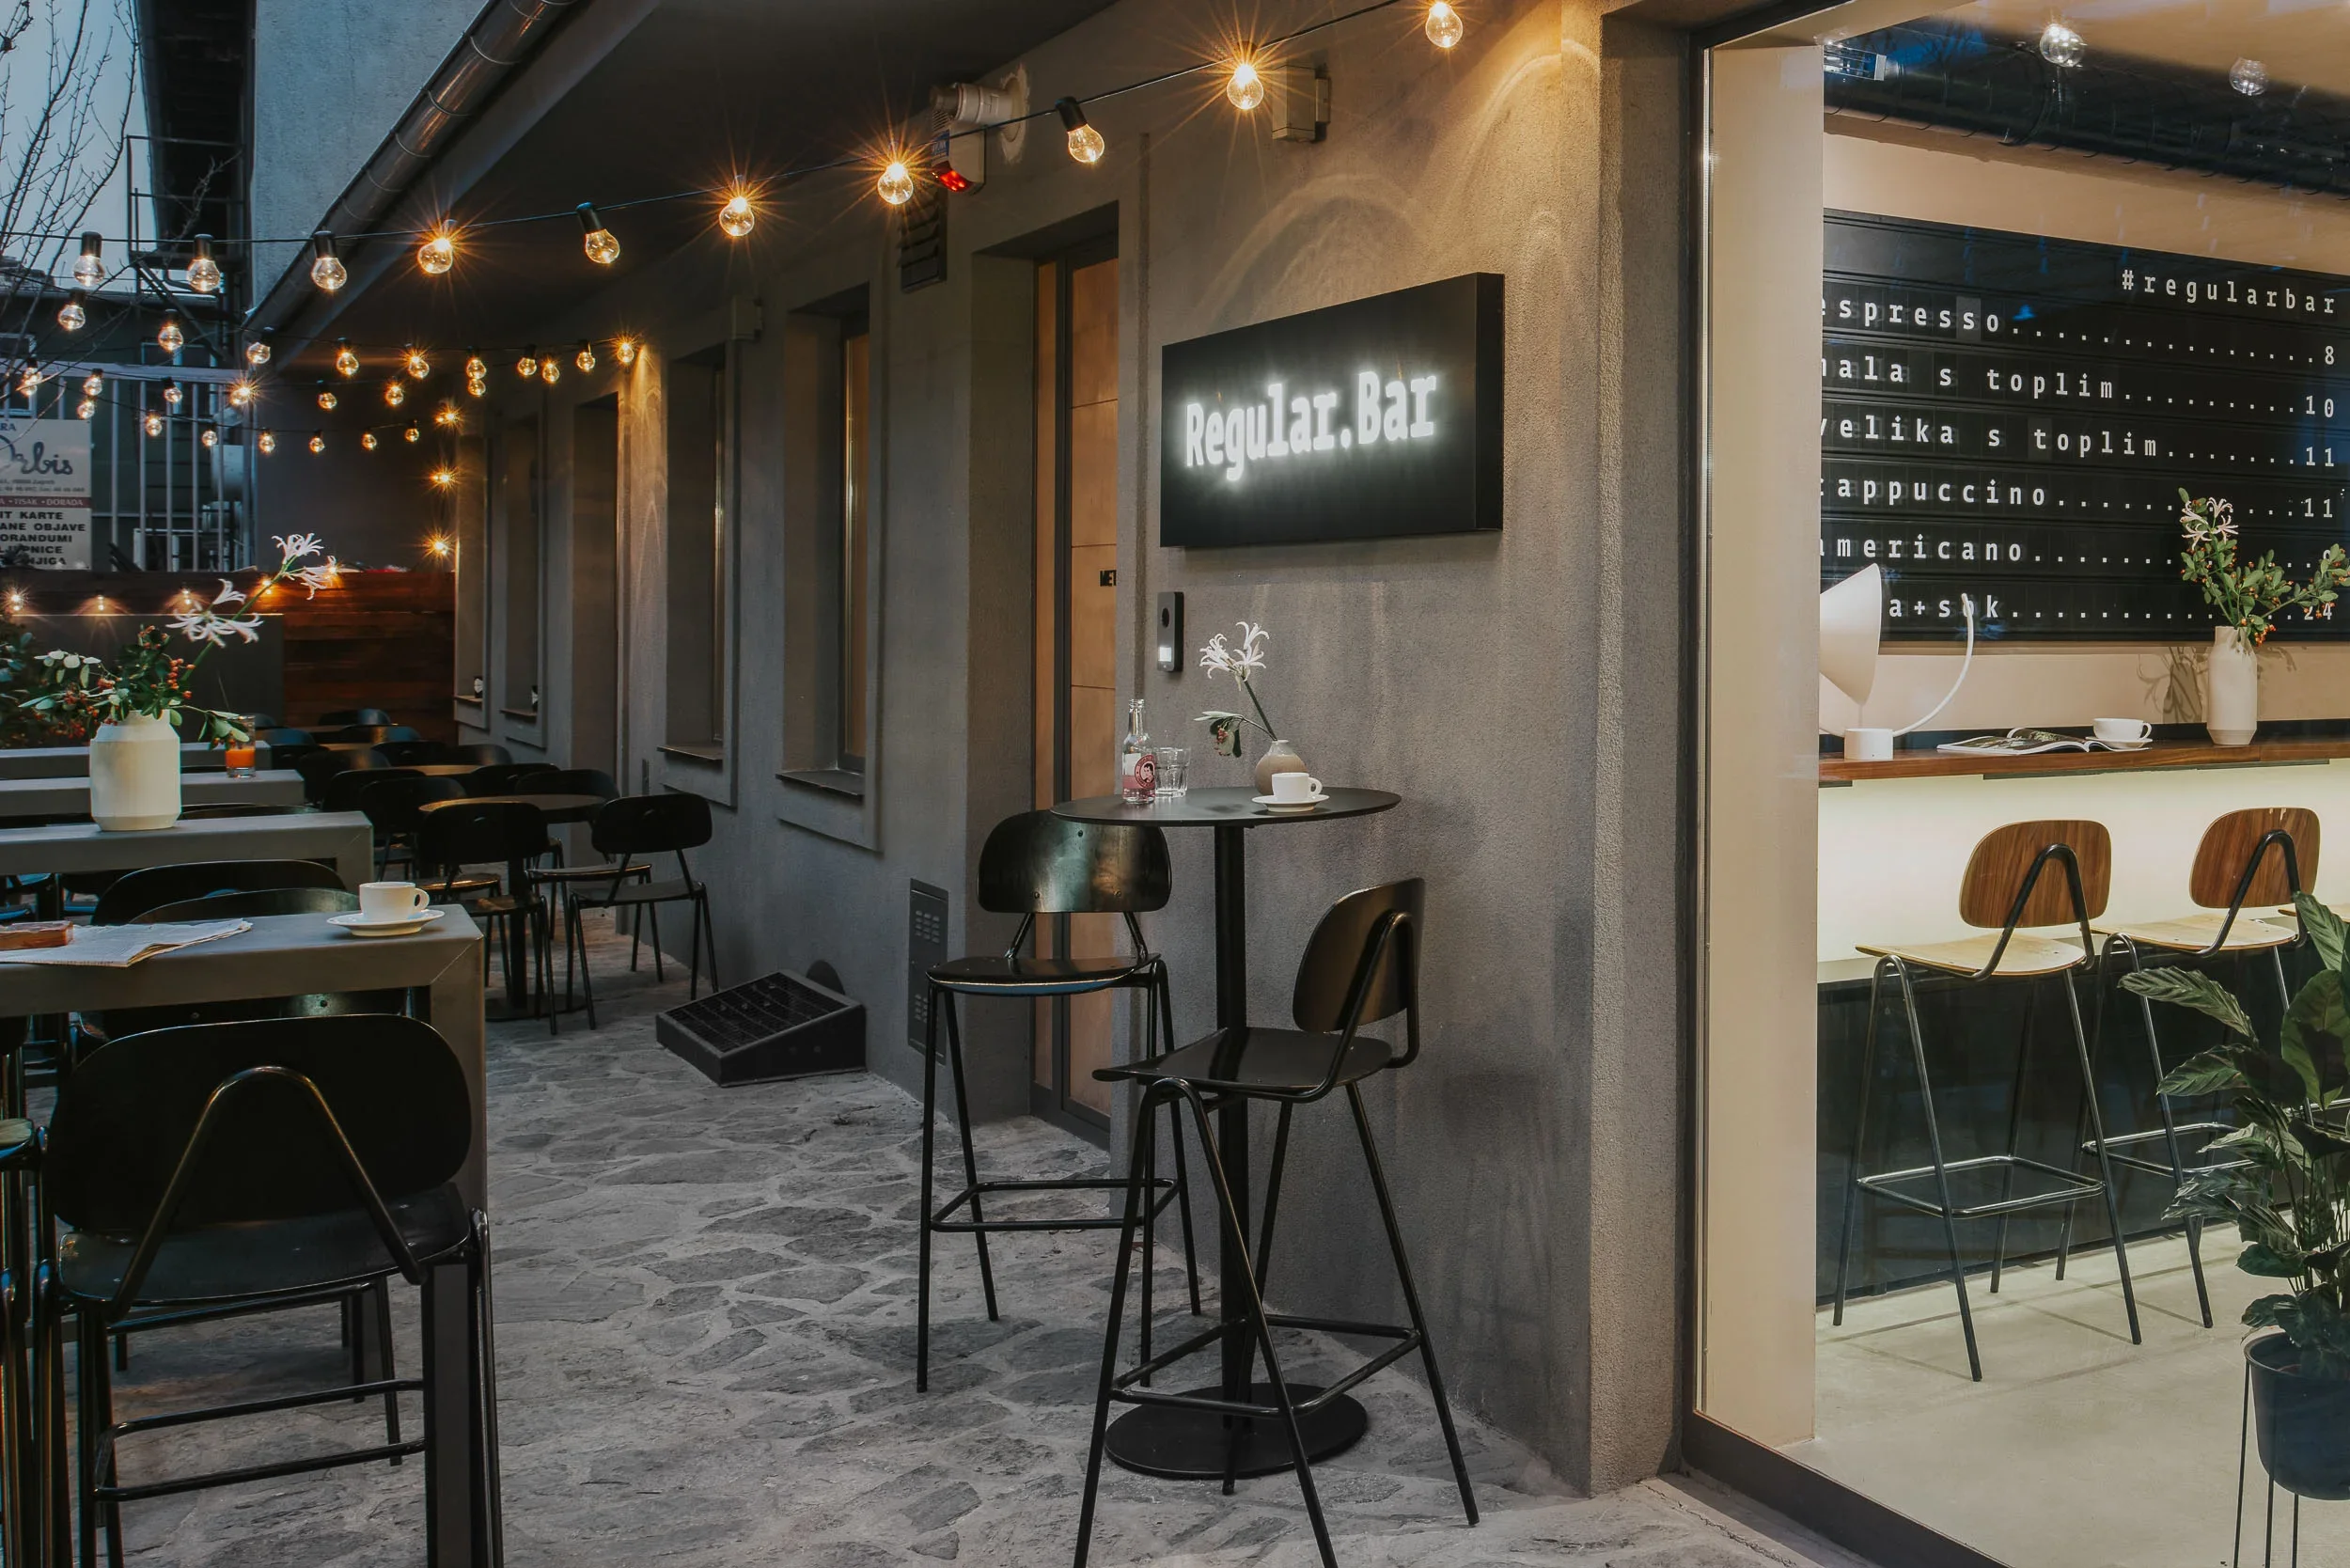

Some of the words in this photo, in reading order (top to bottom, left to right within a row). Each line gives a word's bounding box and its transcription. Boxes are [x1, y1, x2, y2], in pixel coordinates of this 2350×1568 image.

[2122, 269, 2335, 314] #regularbar
[2325, 345, 2335, 365] 8
[1939, 368, 1951, 386] s
[1986, 368, 2112, 400] toplim
[2306, 395, 2334, 418] 10
[1185, 370, 1437, 481] Regular.Bar
[1988, 429, 2000, 447] s
[2034, 429, 2156, 458] toplim
[2306, 447, 2334, 467] 11
[20, 511, 63, 520] KARTE
[2304, 497, 2333, 518] 11
[34, 523, 86, 532] OBJAVE
